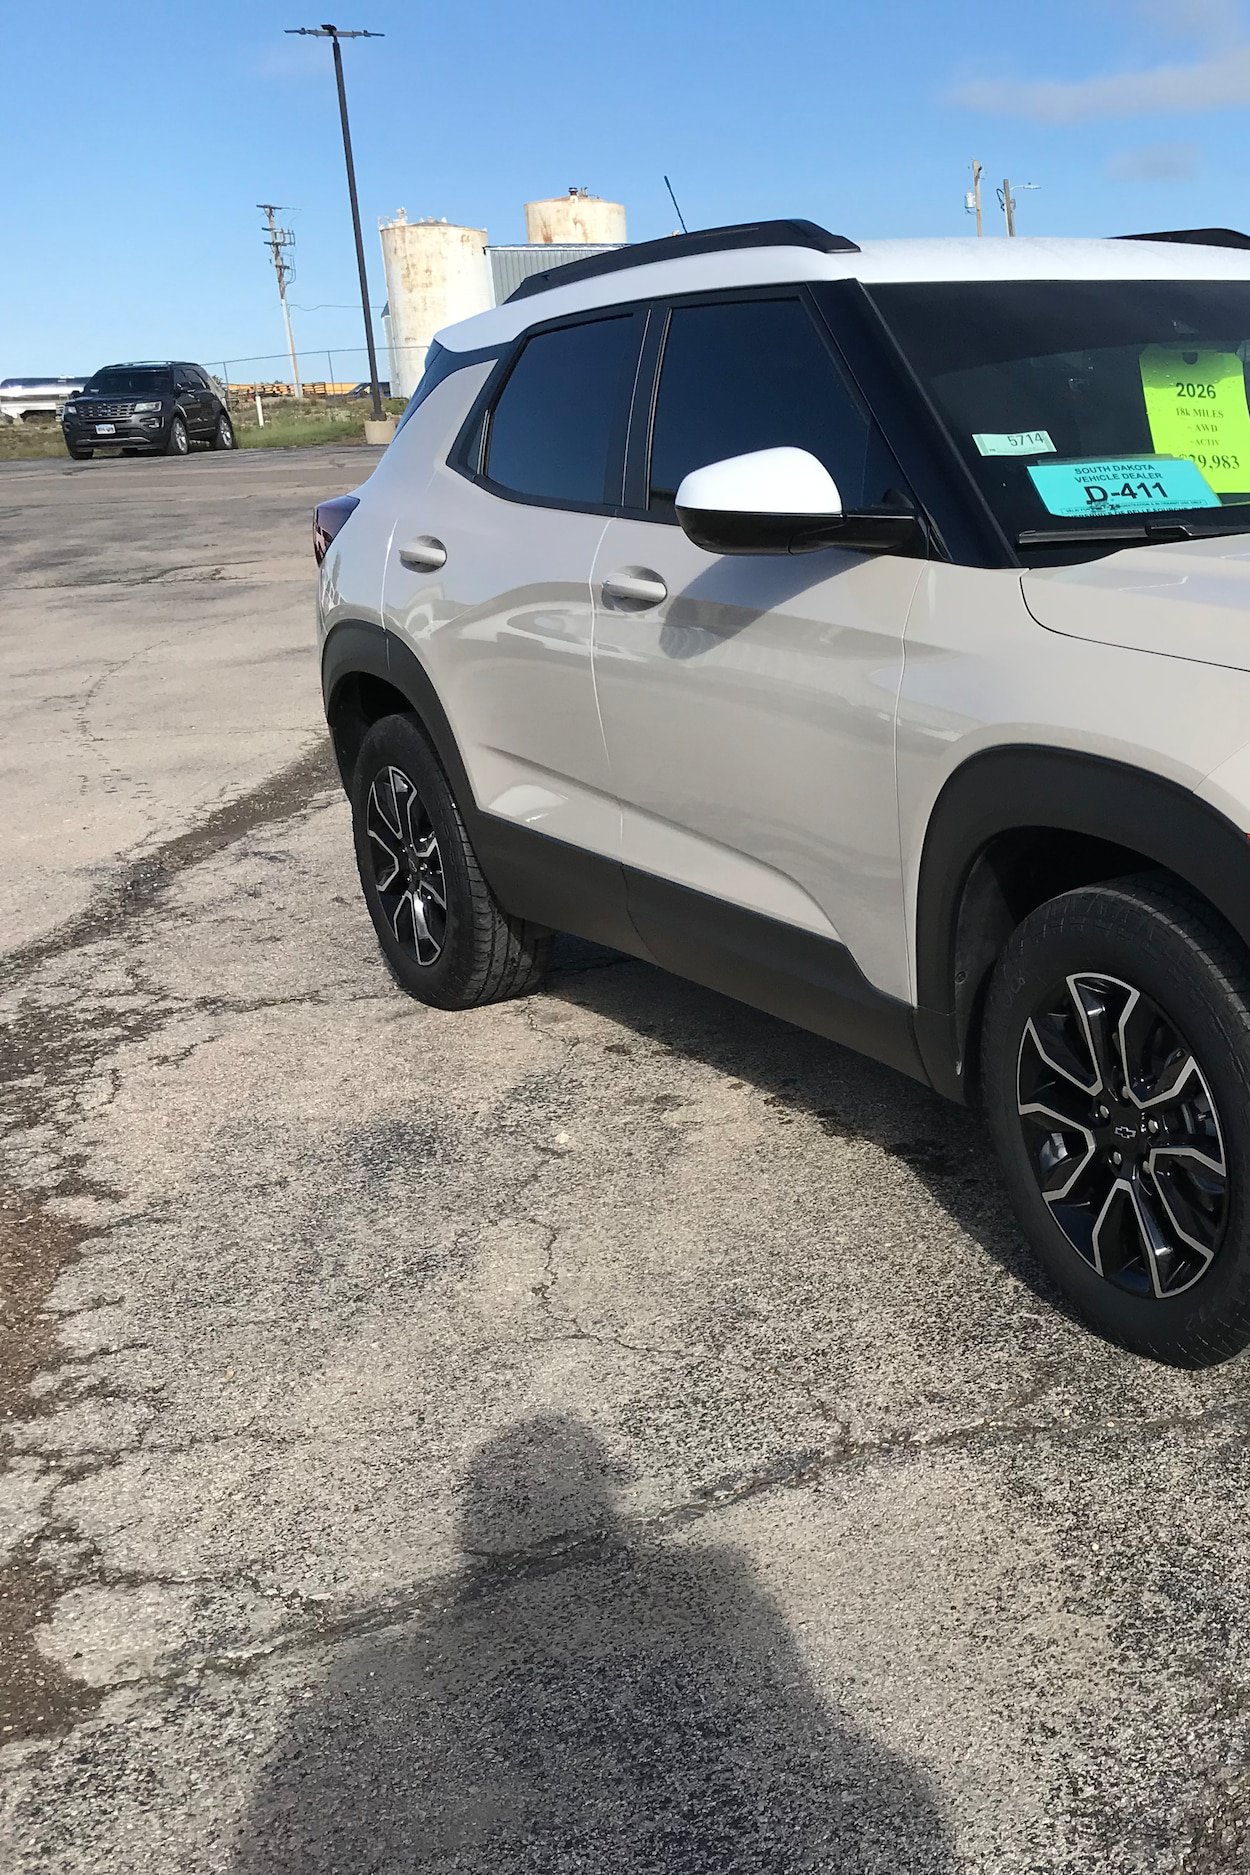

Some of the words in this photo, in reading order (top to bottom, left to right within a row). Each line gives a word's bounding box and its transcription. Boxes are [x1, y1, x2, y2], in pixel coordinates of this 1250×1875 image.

[1176, 382, 1217, 399] 2026
[1193, 408, 1224, 419] MILES
[1007, 432, 1044, 447] 5714
[1074, 465, 1111, 475] SOUTH
[1113, 464, 1156, 472] DAKOTA
[1074, 473, 1120, 483] VEHICLE
[1121, 472, 1164, 480] DEALER
[1083, 482, 1168, 505] D-411
